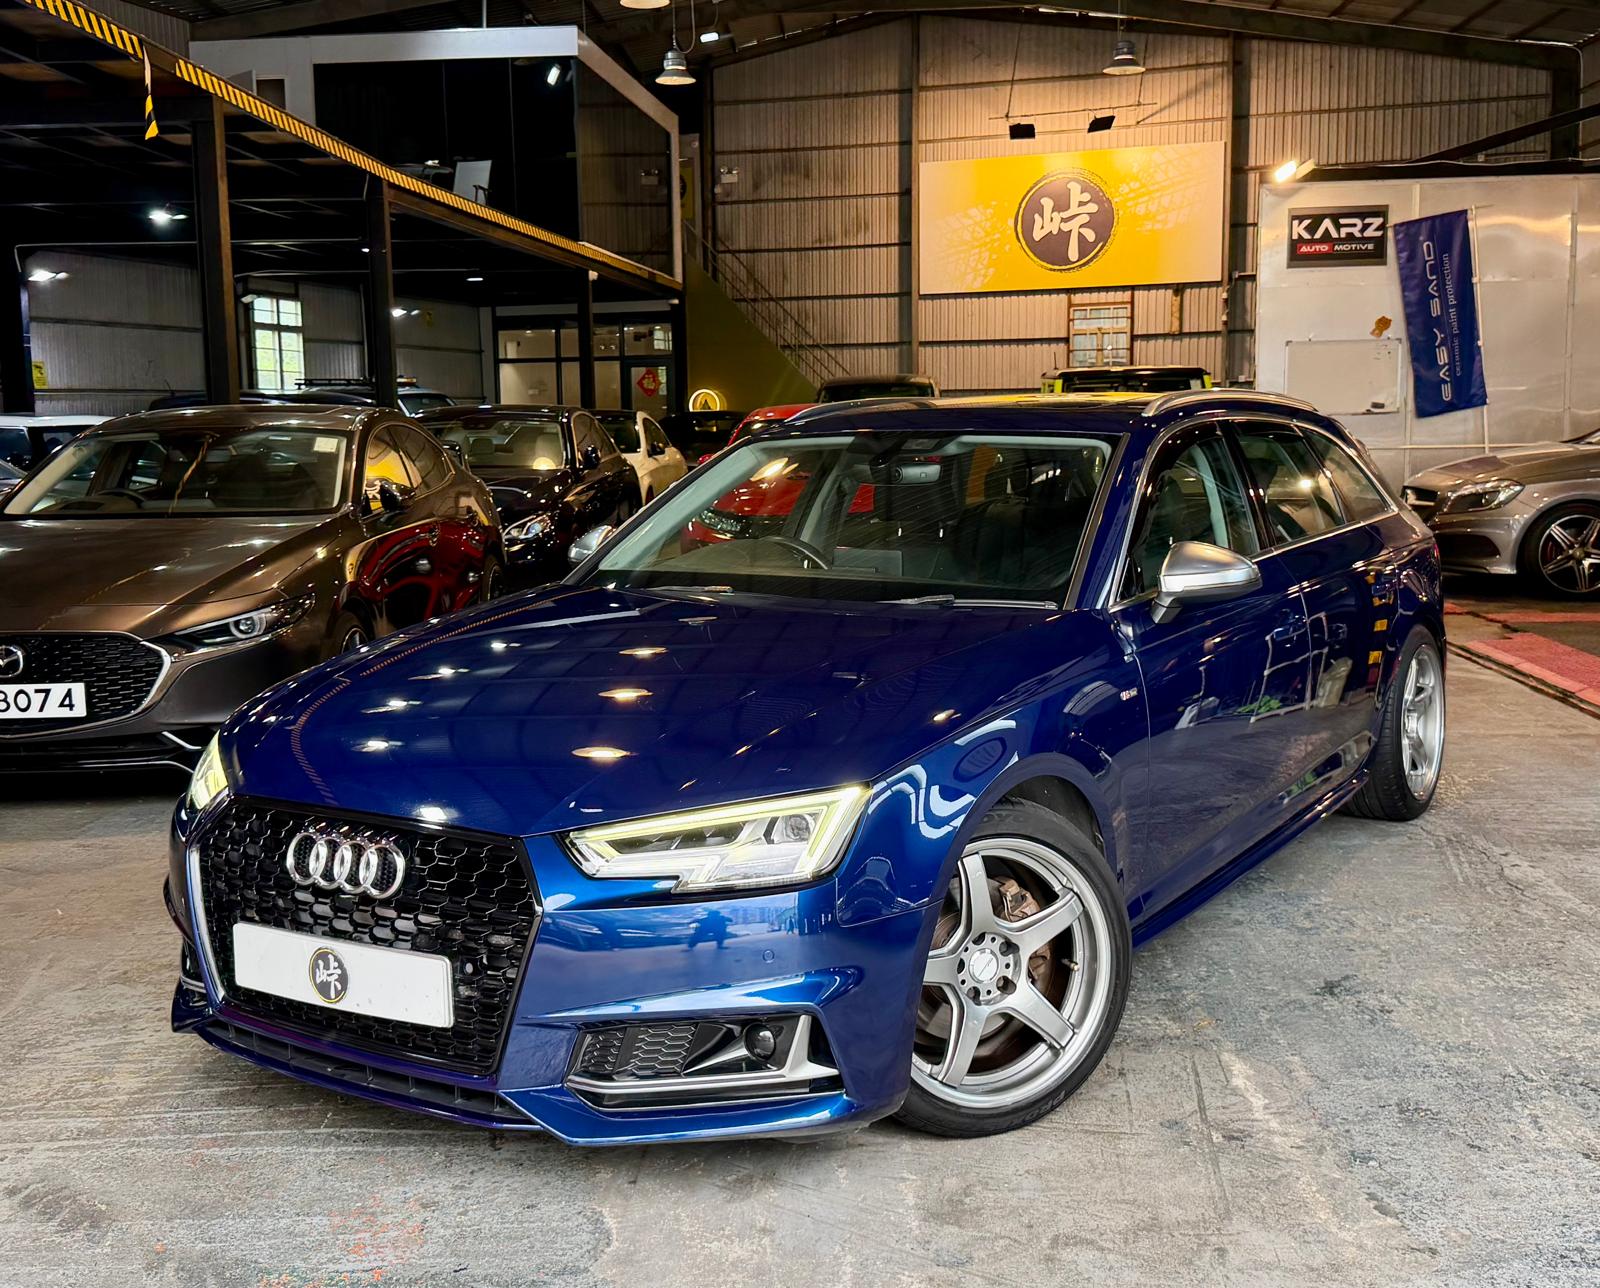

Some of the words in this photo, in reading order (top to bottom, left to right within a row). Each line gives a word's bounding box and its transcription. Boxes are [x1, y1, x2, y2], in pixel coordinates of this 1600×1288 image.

[1031, 180, 1099, 262] 峠
[1291, 217, 1384, 240] KARZ
[1333, 243, 1375, 251] MOTIVE
[1422, 241, 1441, 318] SAND
[1442, 253, 1457, 304] protection
[1448, 308, 1460, 334] paint
[1433, 328, 1452, 401] EASY
[316, 955, 342, 999] 峠
